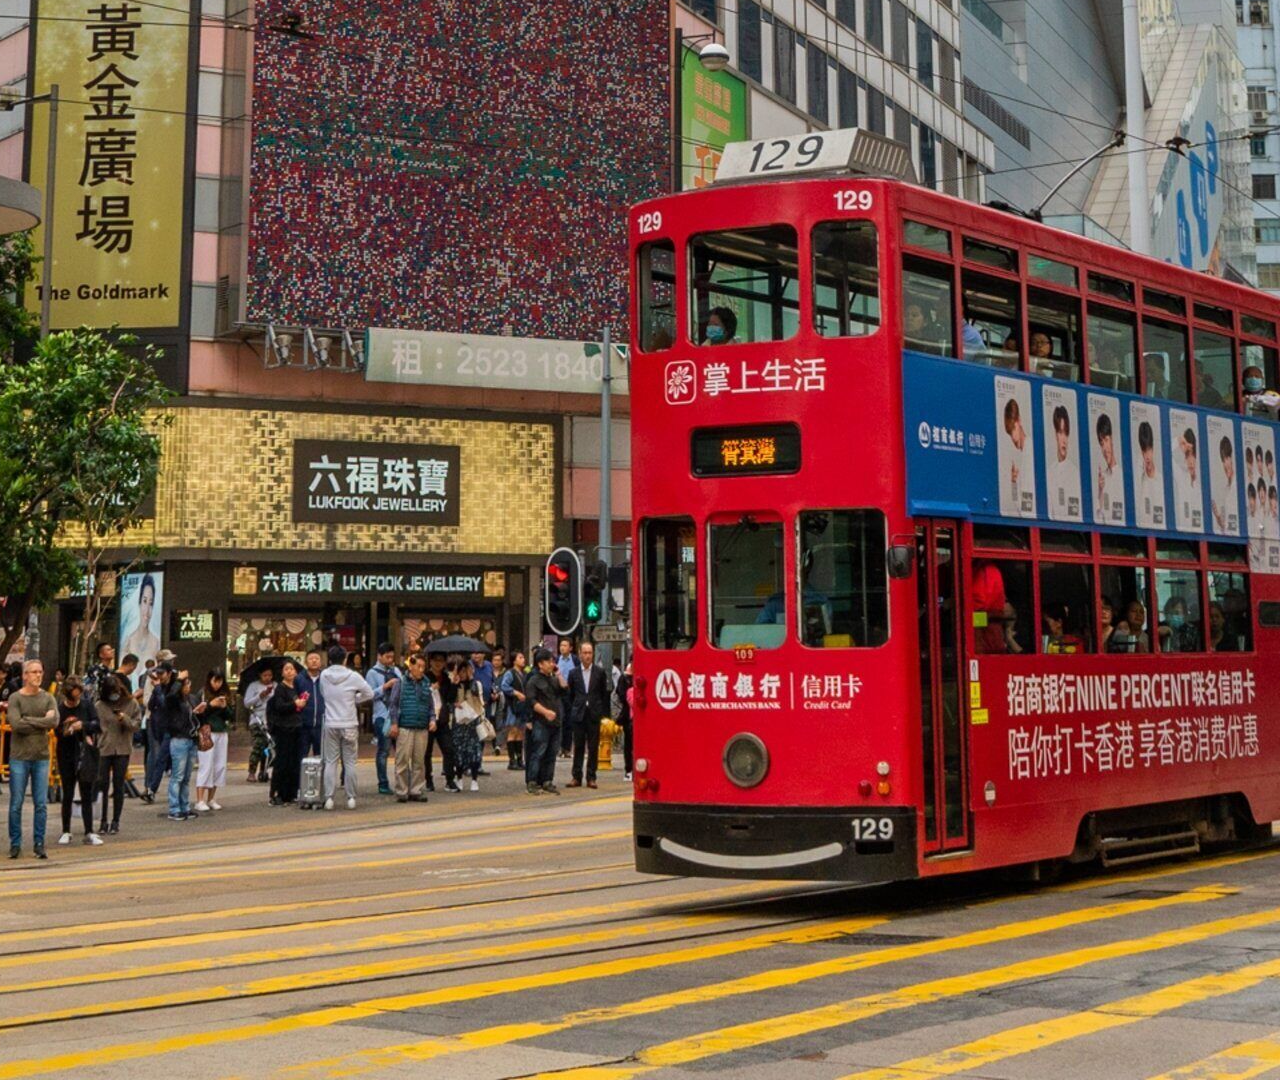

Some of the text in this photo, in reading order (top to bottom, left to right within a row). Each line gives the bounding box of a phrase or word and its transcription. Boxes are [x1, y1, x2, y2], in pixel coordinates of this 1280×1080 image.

[76, 3, 141, 254] 黃金廣場
[749, 135, 824, 173] 129
[833, 190, 873, 210] 129
[637, 211, 662, 234] 129
[77, 282, 169, 301] Goldmark
[456, 346, 527, 376] 2523
[703, 358, 827, 396] 掌上生活
[308, 454, 449, 497] 六福珠寶
[308, 495, 448, 512] LUKFOOK JEWELLERY
[262, 572, 334, 594] 六福珠寶
[342, 575, 481, 592] LUKFOOK JEWELLERY
[180, 612, 213, 631] 六福
[180, 630, 212, 639] LUKFOOK
[735, 650, 754, 660] 109
[801, 673, 864, 699] 信用卡
[688, 700, 852, 710] CHINA MERCHANTS BANK Credit Card
[1007, 712, 1259, 781] 陪你打卡香港 享香港消费优惠
[851, 818, 894, 840] 129
